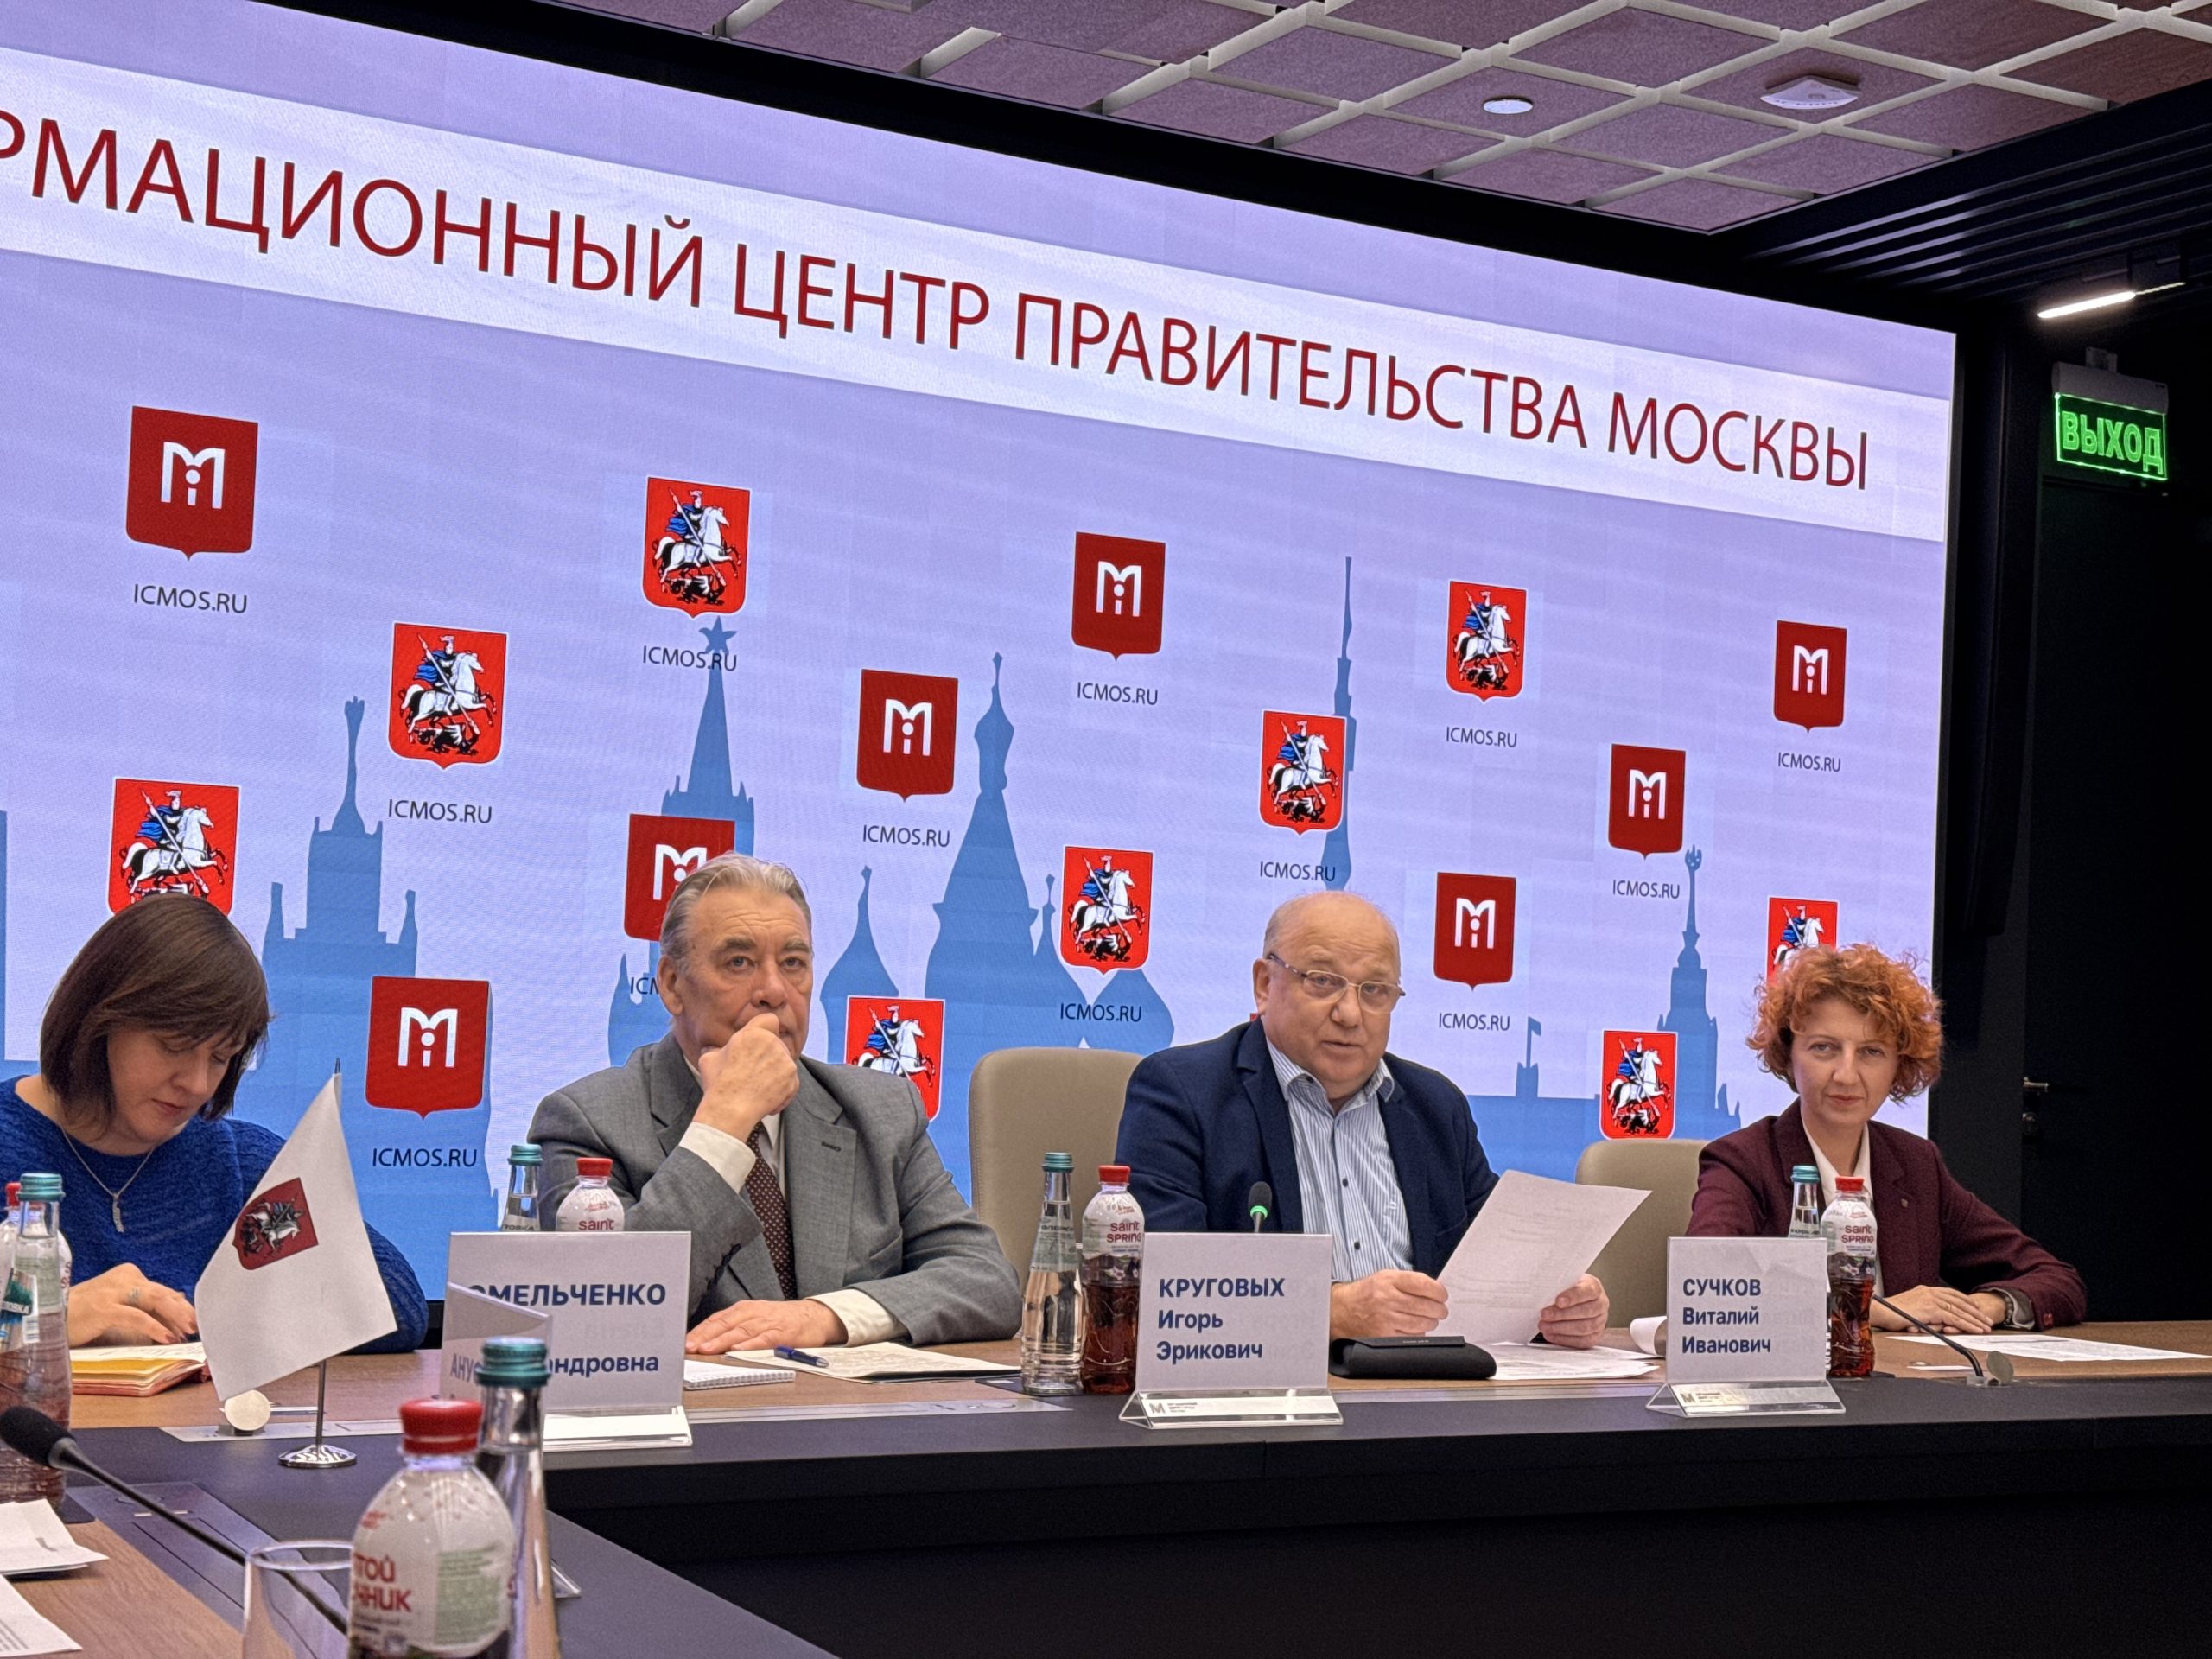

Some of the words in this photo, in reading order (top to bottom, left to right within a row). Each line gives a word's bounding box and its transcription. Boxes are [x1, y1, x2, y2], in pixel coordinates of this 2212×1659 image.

[734, 244, 989, 350] ЦЕНТР
[1015, 292, 1587, 448] ПРАВИТЕЛЬСТВА
[1608, 392, 1867, 490] МОСКВЫ
[2061, 410, 2164, 474] ВЫХОД
[133, 584, 248, 614] ICMOS.RU
[642, 645, 737, 671] ICMOS.RU
[1077, 682, 1159, 706] ICMOS.RU
[1446, 726, 1517, 748] ICMOS.RU
[1777, 753, 1841, 772] ICMOS.RU
[388, 798, 493, 824] ICMOS.RU
[863, 824, 950, 847] ICMOS.RU
[1260, 861, 1336, 881] ICMOS.RU
[1612, 880, 1681, 899] ICMOS.RU
[1060, 1003, 1141, 1023] ICMOS.RU
[1438, 1012, 1510, 1032] ICMOS.RU
[372, 1148, 477, 1167] ICMOS.RU
[578, 1217, 615, 1230] saint
[1110, 1220, 1141, 1232] saint
[1845, 1224, 1872, 1234] saint
[1159, 1278, 1285, 1298] КРУГОВЫХ
[1682, 1278, 1761, 1297] СУЧКОВ
[1158, 1309, 1224, 1333] Игорь
[1682, 1306, 1759, 1325] Виталий
[1156, 1340, 1262, 1364] Эрикович
[1682, 1336, 1771, 1354] Иванович
